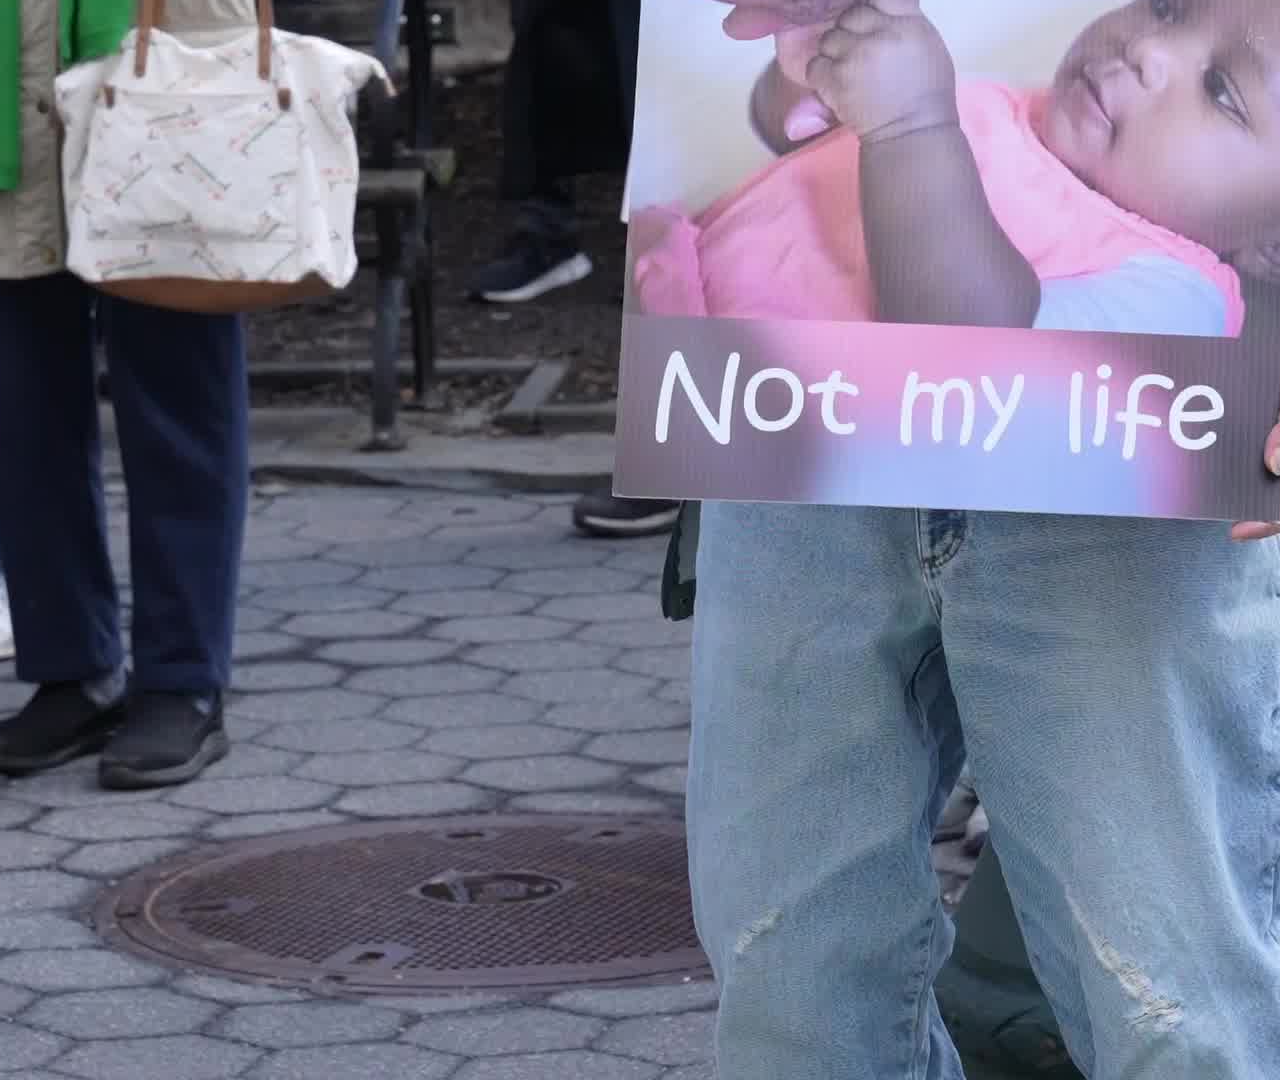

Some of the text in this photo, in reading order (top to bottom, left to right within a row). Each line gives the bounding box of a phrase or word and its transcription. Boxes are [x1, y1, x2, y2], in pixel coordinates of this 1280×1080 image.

[654, 350, 1226, 460] Not my life
